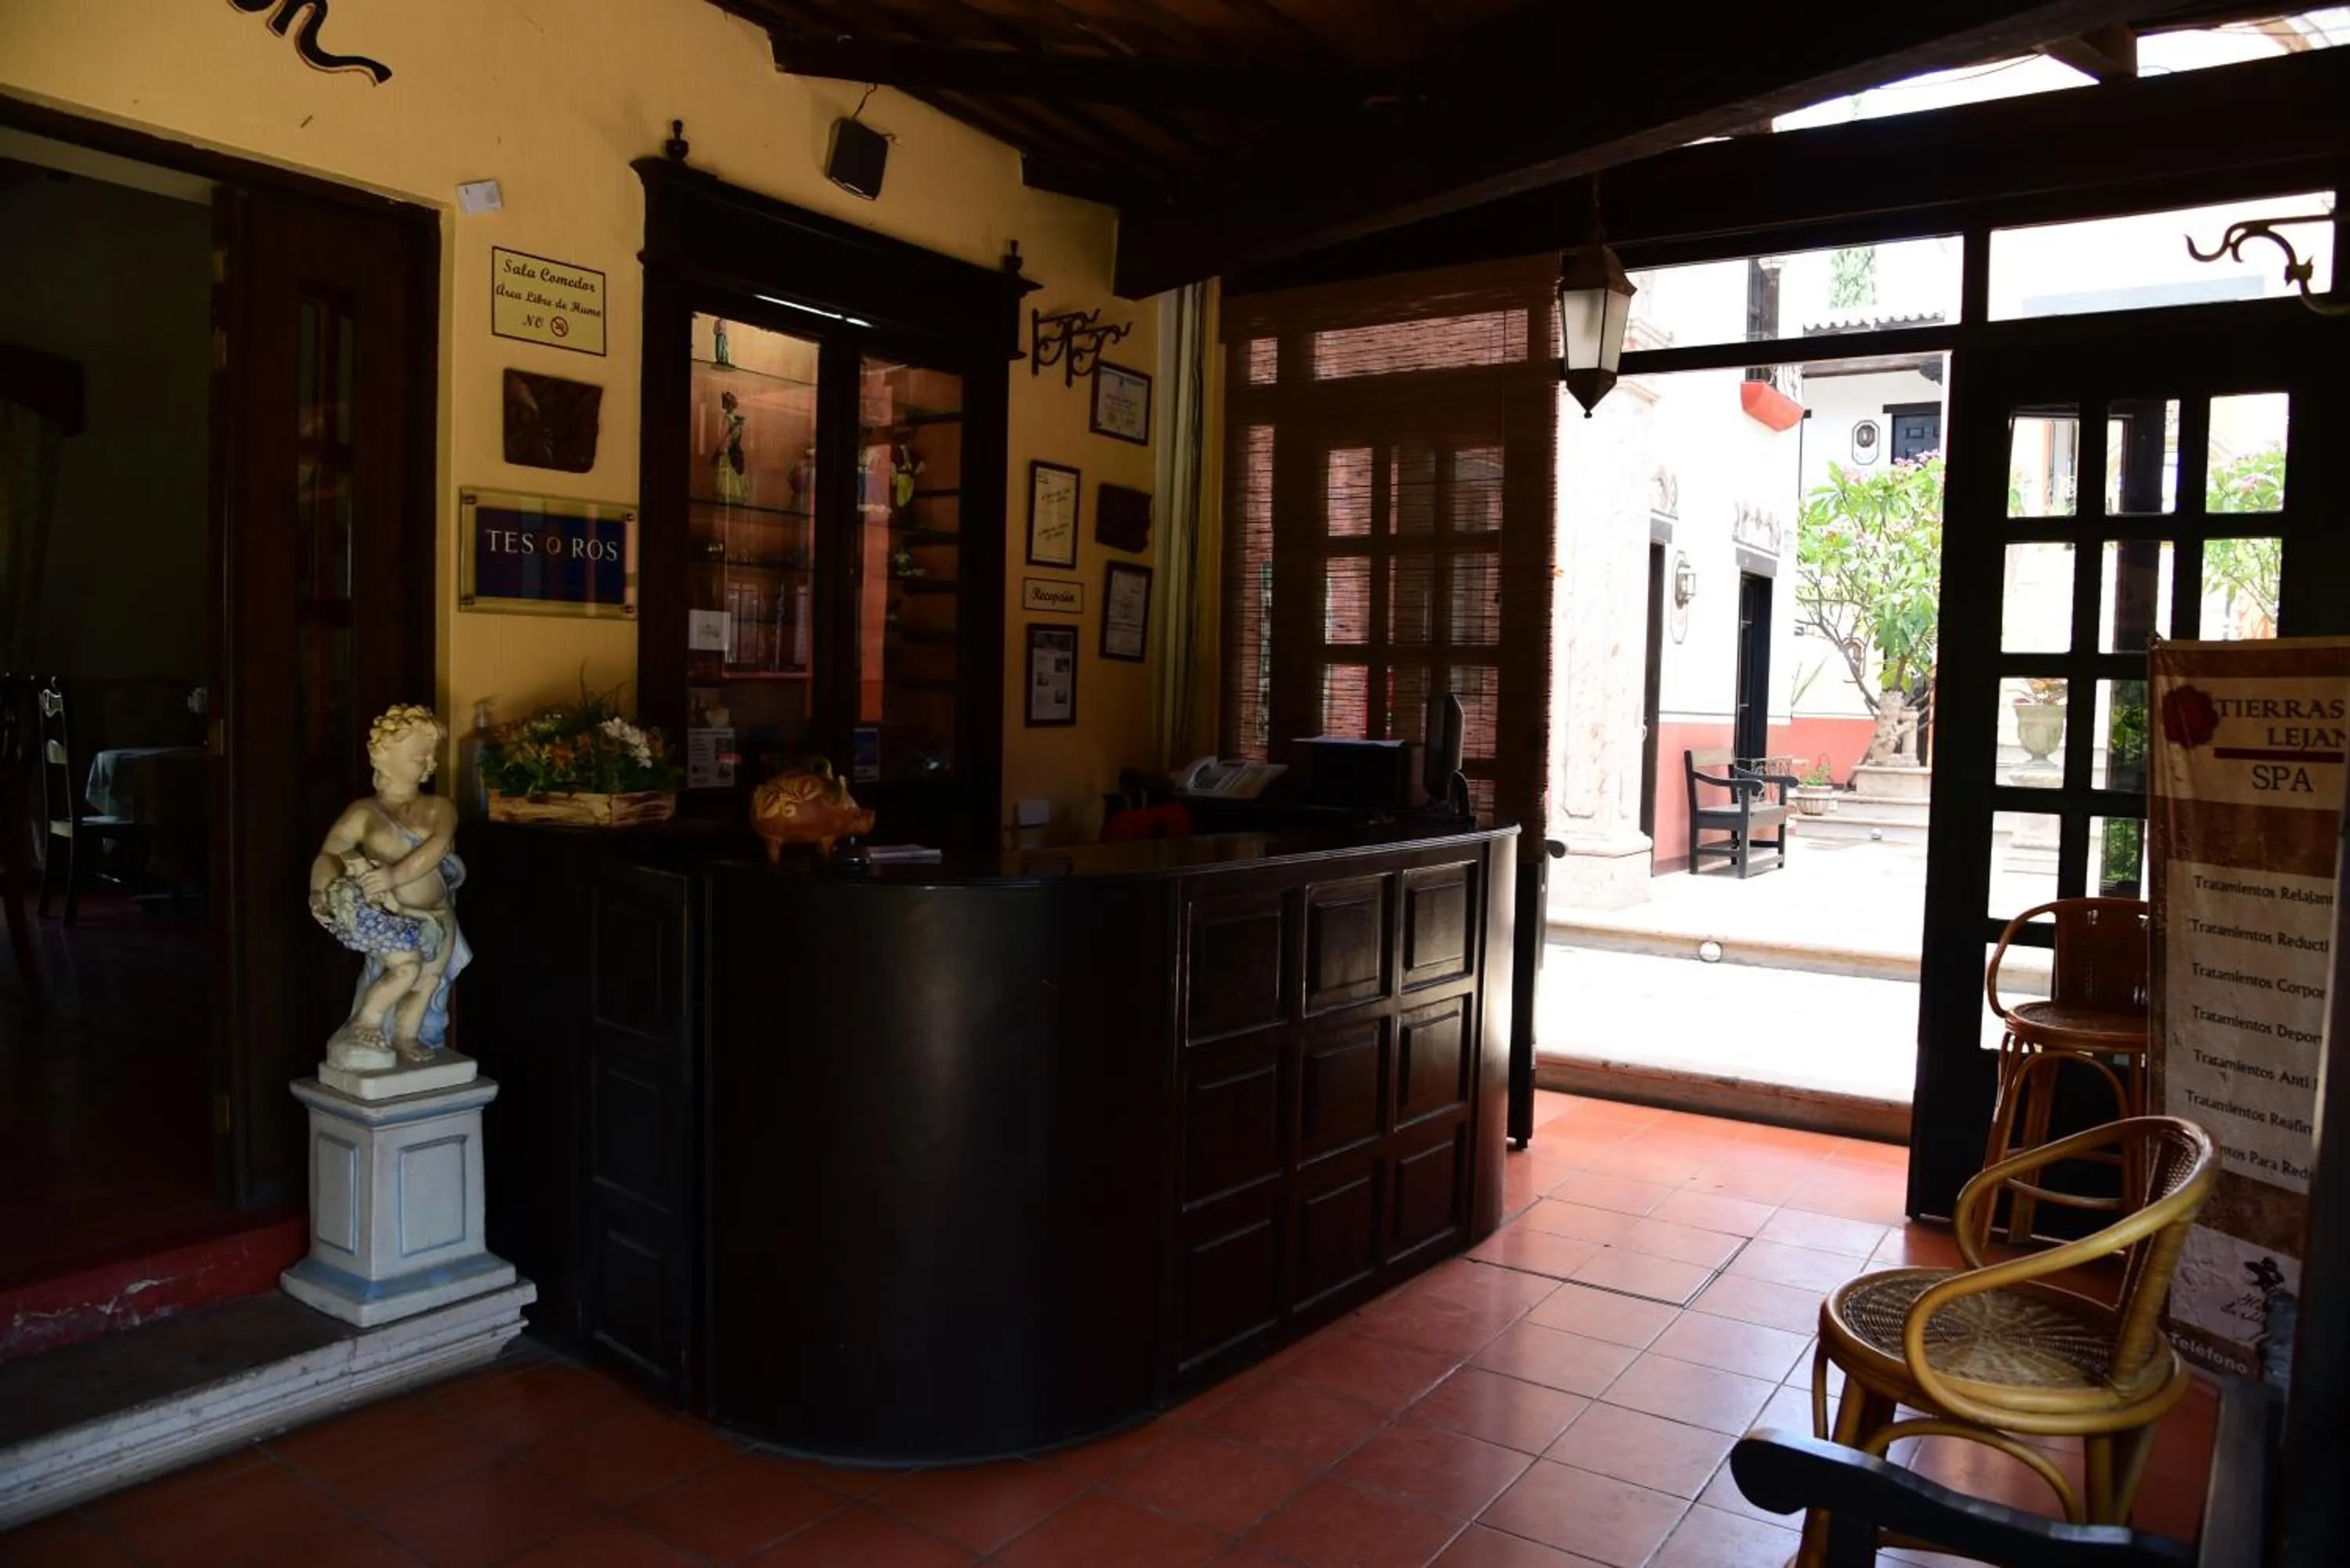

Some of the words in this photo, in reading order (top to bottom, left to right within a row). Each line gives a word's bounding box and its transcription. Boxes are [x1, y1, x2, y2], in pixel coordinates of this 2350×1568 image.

[503, 258, 536, 278] Sala
[540, 267, 595, 293] Comedor
[526, 291, 553, 307] Libre
[555, 298, 566, 311] de
[522, 314, 544, 328] NO
[2215, 699, 2345, 720] TIERRAS
[2251, 764, 2314, 793] SPA
[2193, 875, 2276, 899] Tratamientos
[2190, 919, 2272, 945] Tratamientos
[2192, 963, 2272, 990] Tratamientos
[2192, 1006, 2272, 1035] Tratamientos
[2193, 1049, 2274, 1080] Tratamientos
[2279, 1071, 2308, 1089] Anti
[2185, 1089, 2265, 1123] Tratamientos
[2250, 1150, 2277, 1172] Para
[2167, 1332, 2247, 1375] Teléfono
